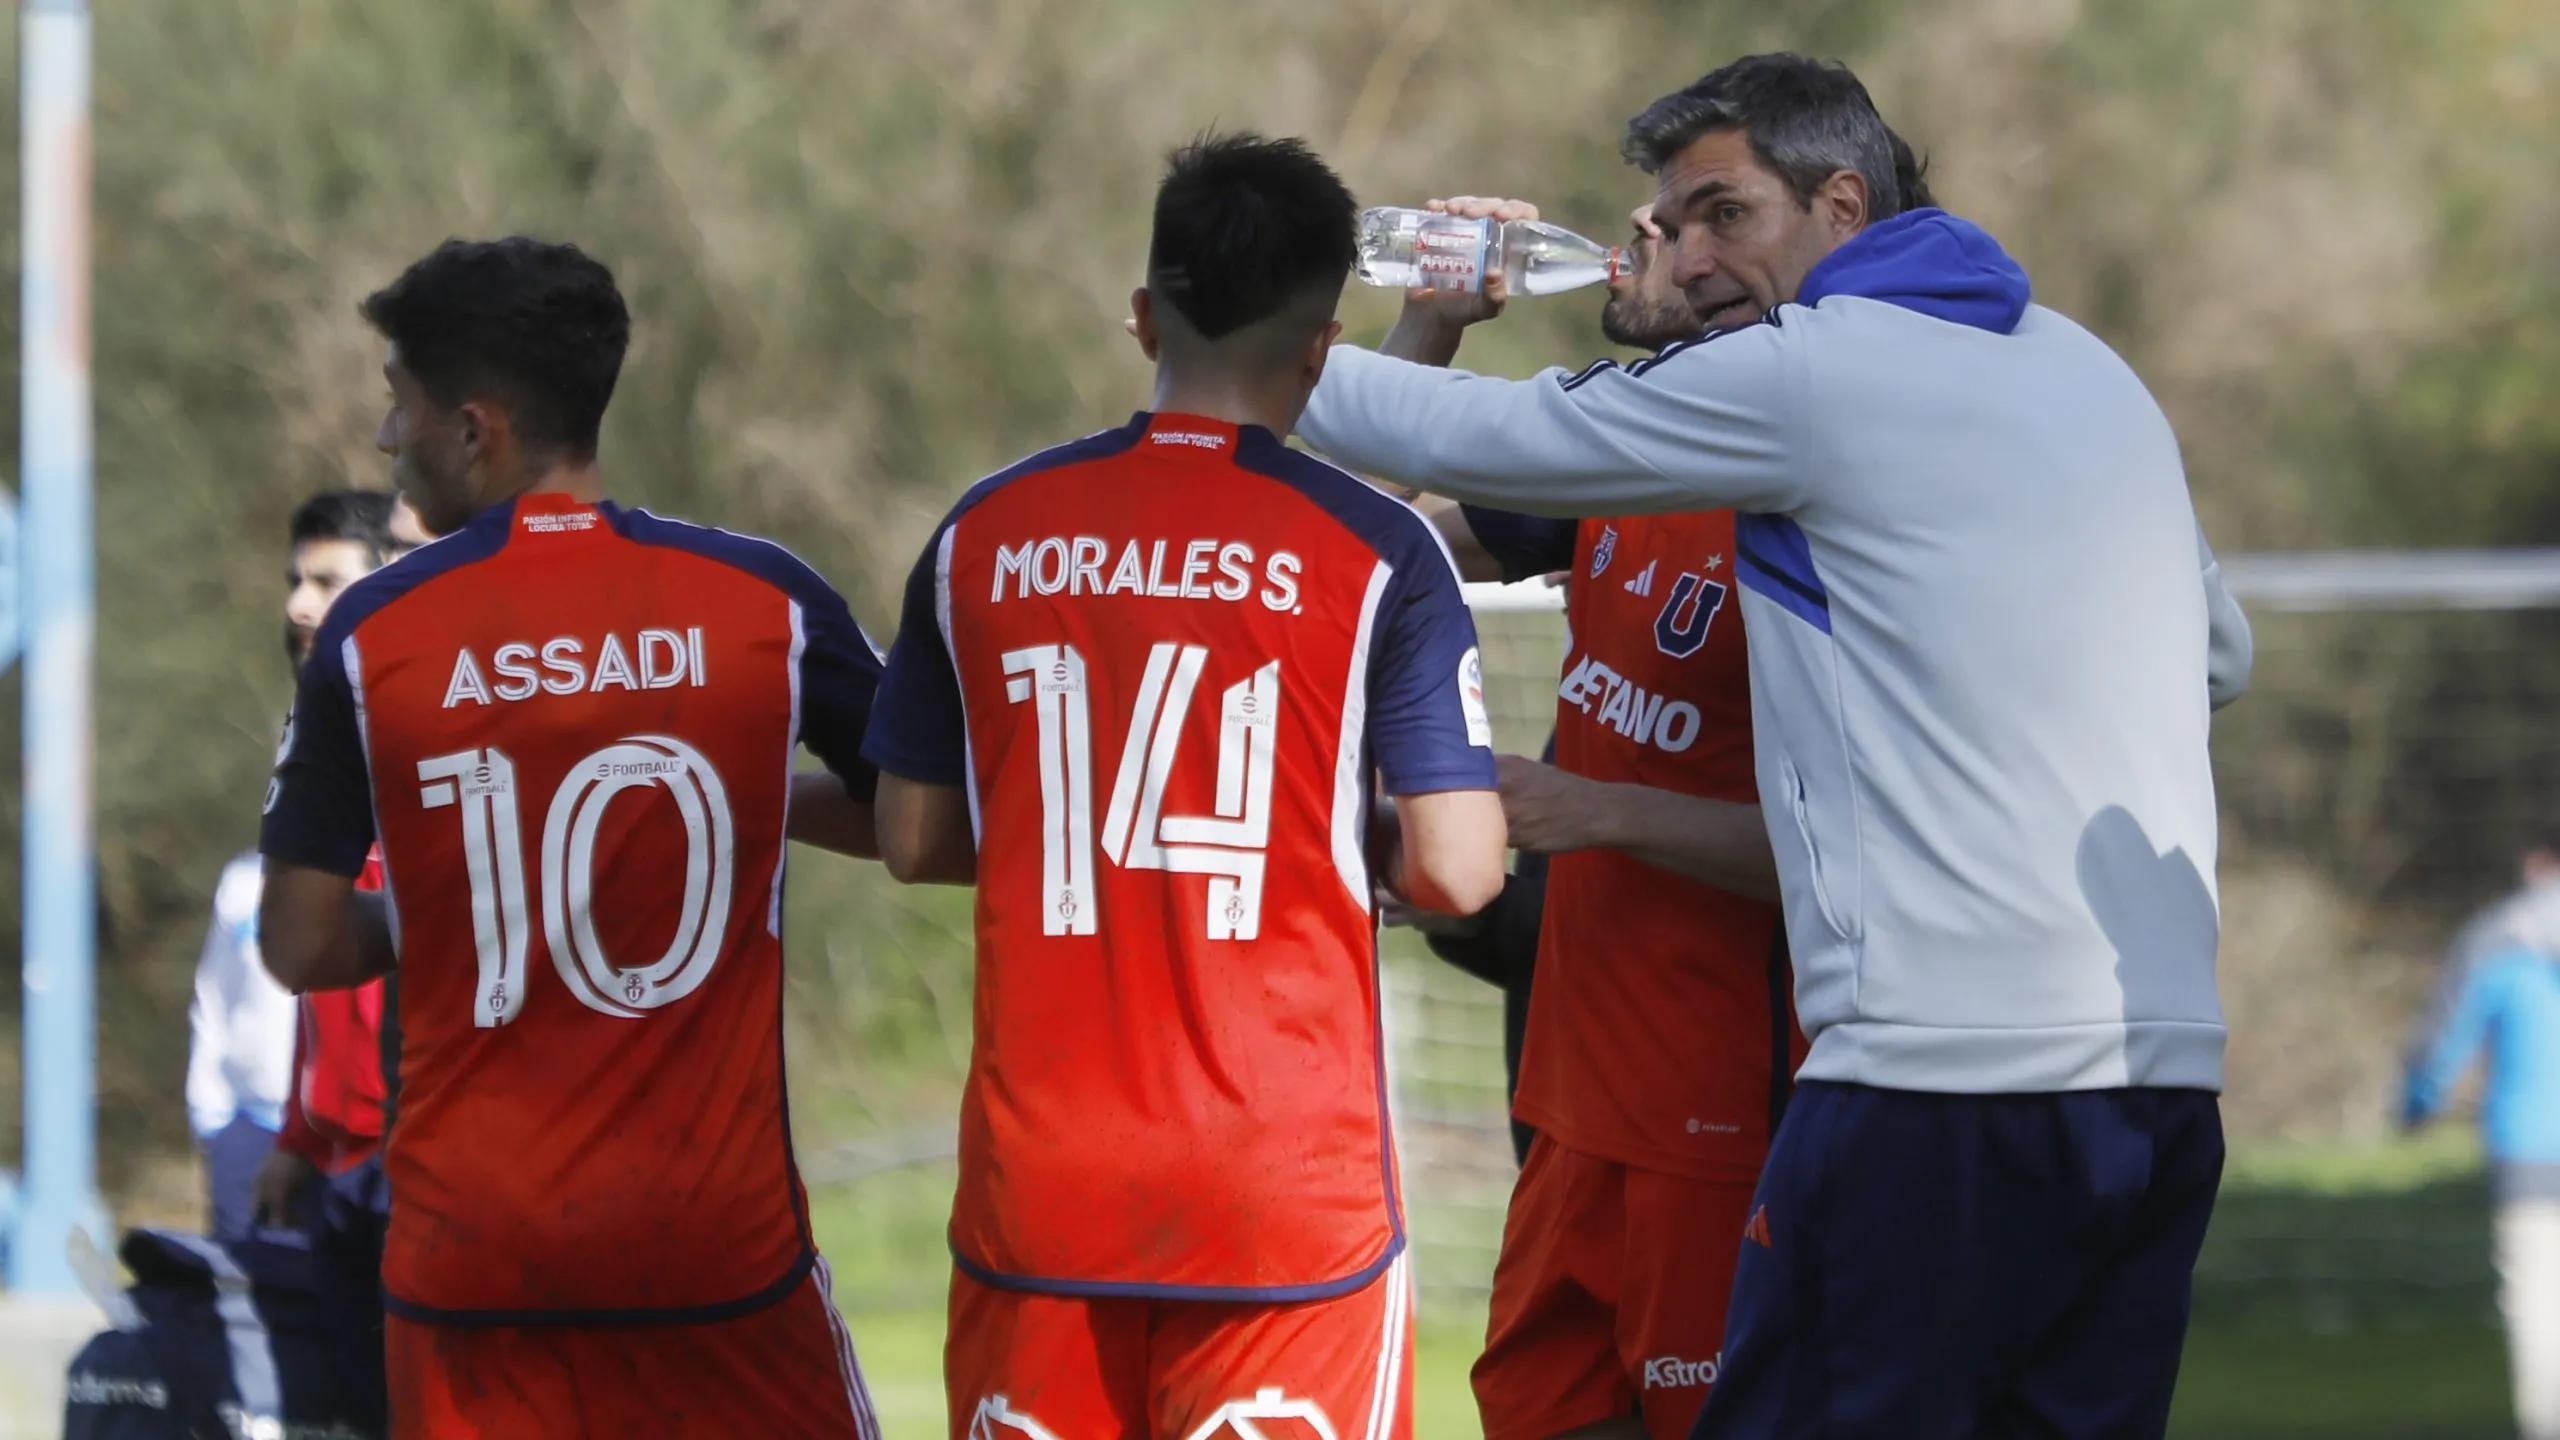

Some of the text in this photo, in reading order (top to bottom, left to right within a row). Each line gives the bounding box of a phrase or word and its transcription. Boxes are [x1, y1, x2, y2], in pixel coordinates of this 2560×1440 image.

[528, 522, 593, 532] LOCURA TOTAL
[991, 536, 1302, 616] MORALES S.
[442, 626, 704, 708] ASSADI
[1559, 653, 1701, 753] BETANO
[1001, 642, 1279, 941] 14
[416, 735, 735, 1028] 10
